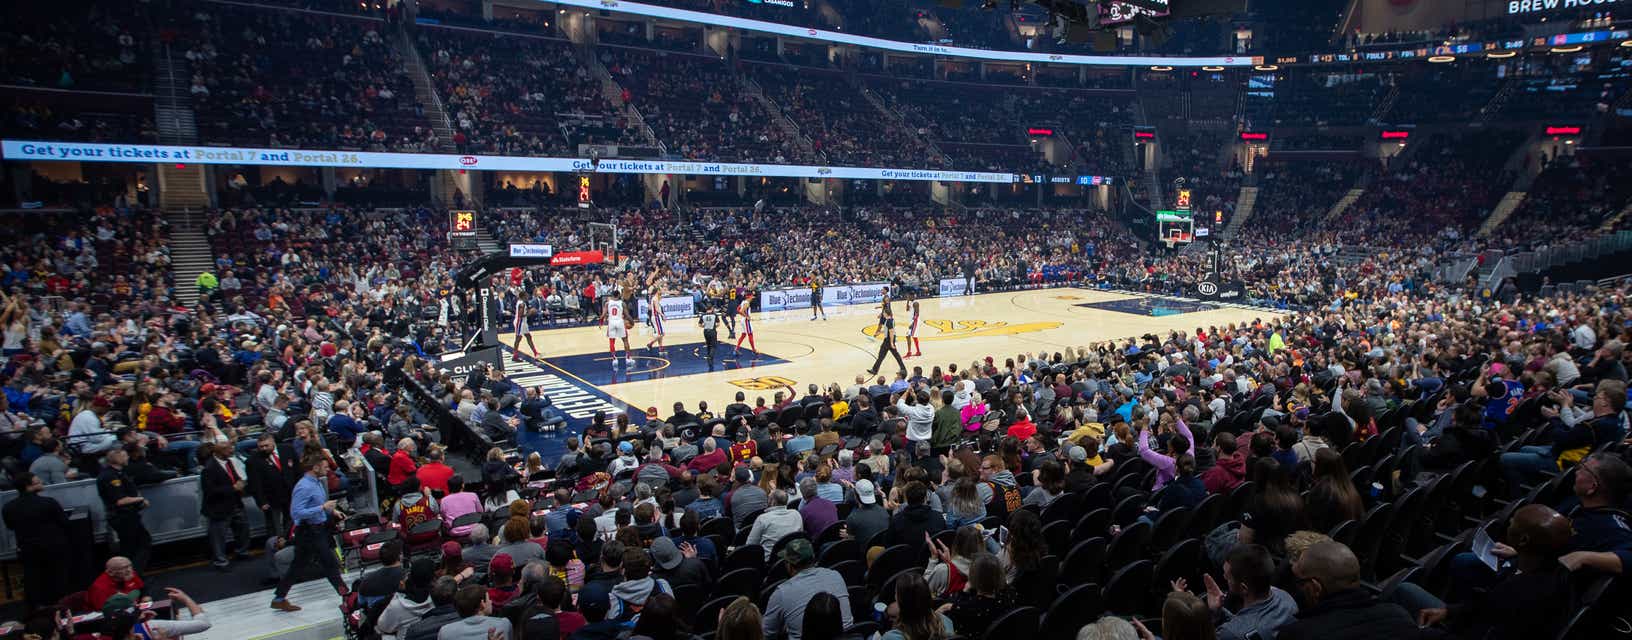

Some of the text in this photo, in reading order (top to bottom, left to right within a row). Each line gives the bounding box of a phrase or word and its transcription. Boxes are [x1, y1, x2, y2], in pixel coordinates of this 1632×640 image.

[1508, 0, 1559, 14] BREW
[21, 144, 55, 155] Get
[60, 147, 104, 158] your
[109, 147, 169, 159] tickets
[174, 149, 191, 159] at
[194, 150, 244, 161] Portal
[248, 151, 257, 161] 7
[260, 152, 290, 162] and
[294, 152, 337, 163] Portal
[573, 160, 591, 169] Get
[619, 162, 653, 171] tickets
[654, 163, 665, 171] at
[667, 162, 695, 172] Portal
[703, 164, 721, 172] and
[911, 171, 933, 179] tickets
[769, 294, 781, 305] Blue
[836, 289, 848, 301] Blue
[663, 303, 692, 313] chnologies
